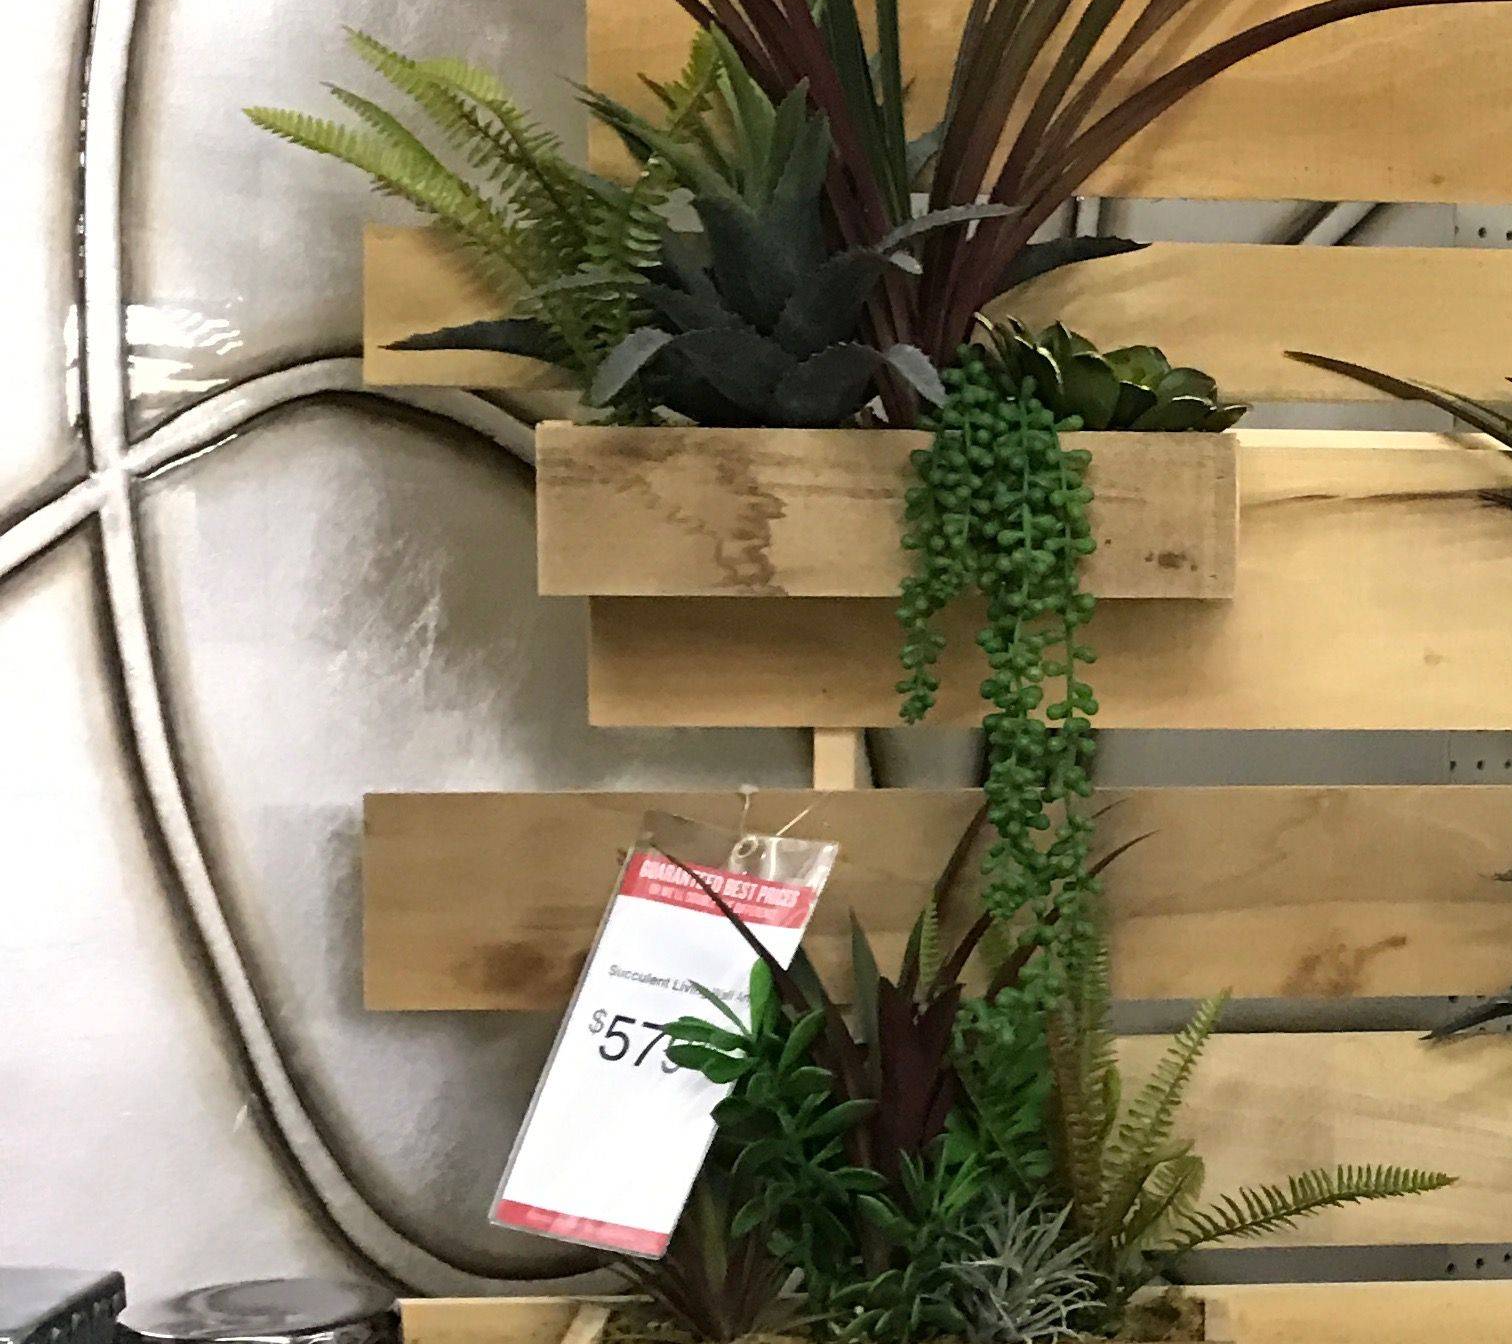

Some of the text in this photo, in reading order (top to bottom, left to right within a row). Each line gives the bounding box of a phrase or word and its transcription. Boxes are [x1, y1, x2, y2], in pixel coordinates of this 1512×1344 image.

[722, 877, 758, 900] BEST
[608, 964, 671, 989] Succulent
[588, 1008, 681, 1074] $57
